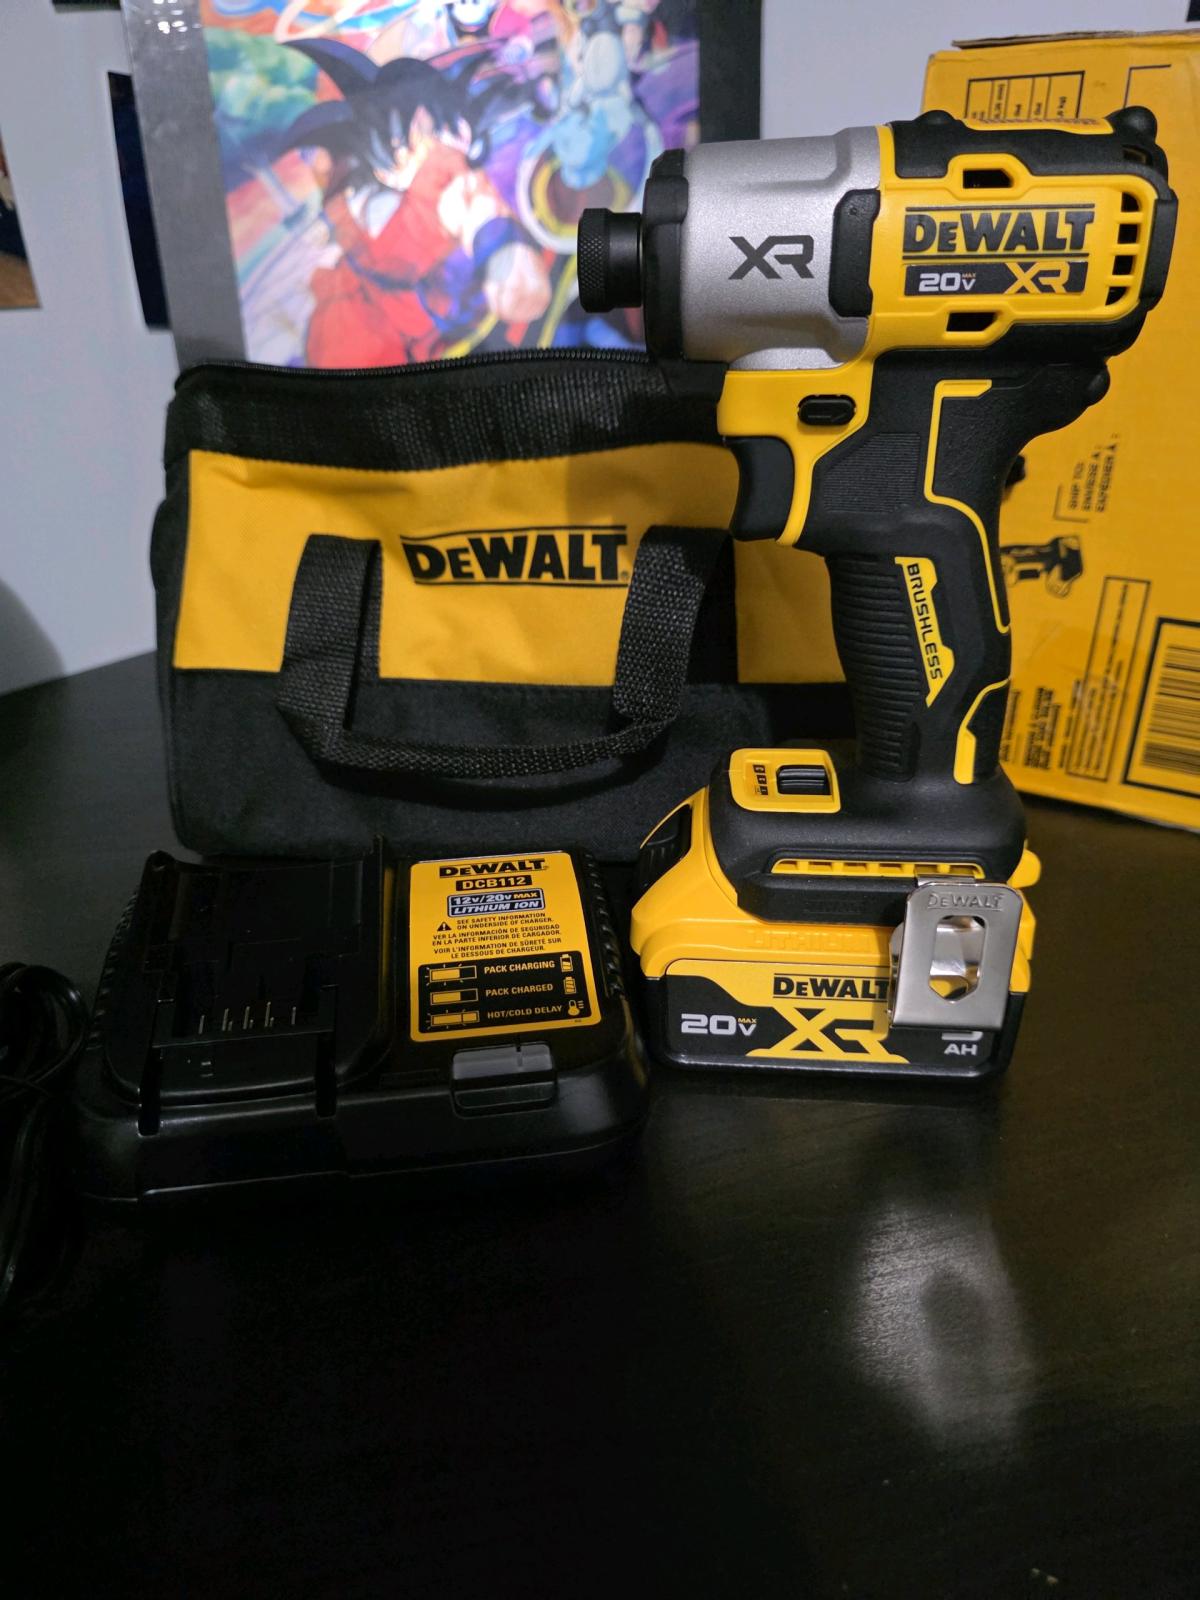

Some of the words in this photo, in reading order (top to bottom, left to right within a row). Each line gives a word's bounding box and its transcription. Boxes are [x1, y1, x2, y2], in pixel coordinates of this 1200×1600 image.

[903, 210, 1095, 253] DEWALT
[728, 234, 814, 280] XR
[1003, 262, 1070, 294] XR
[402, 533, 628, 581] DEWALT
[907, 563, 943, 680] BRUSHLESS
[439, 859, 545, 877] DEWALT
[462, 877, 526, 890] DCB112
[454, 903, 510, 914] LITHIUM
[514, 900, 539, 909] ION
[928, 891, 1004, 909] DEWALT
[469, 921, 509, 929] UNDERSIDE
[471, 916, 496, 924] SAFETY
[498, 912, 546, 921] INFORMATION
[521, 924, 560, 932] SEGURIDAD
[478, 934, 510, 942] INFERIOR
[452, 942, 507, 952] L'INFORMATION
[461, 950, 494, 958] DESSOUS
[484, 964, 507, 975] PACK
[509, 960, 556, 972] CHARGING
[485, 987, 509, 997] PACK
[511, 983, 554, 994] CHARGED
[487, 1007, 533, 1019] HOT/COLD
[534, 1004, 563, 1014] DELAY
[943, 1043, 978, 1056] AH
